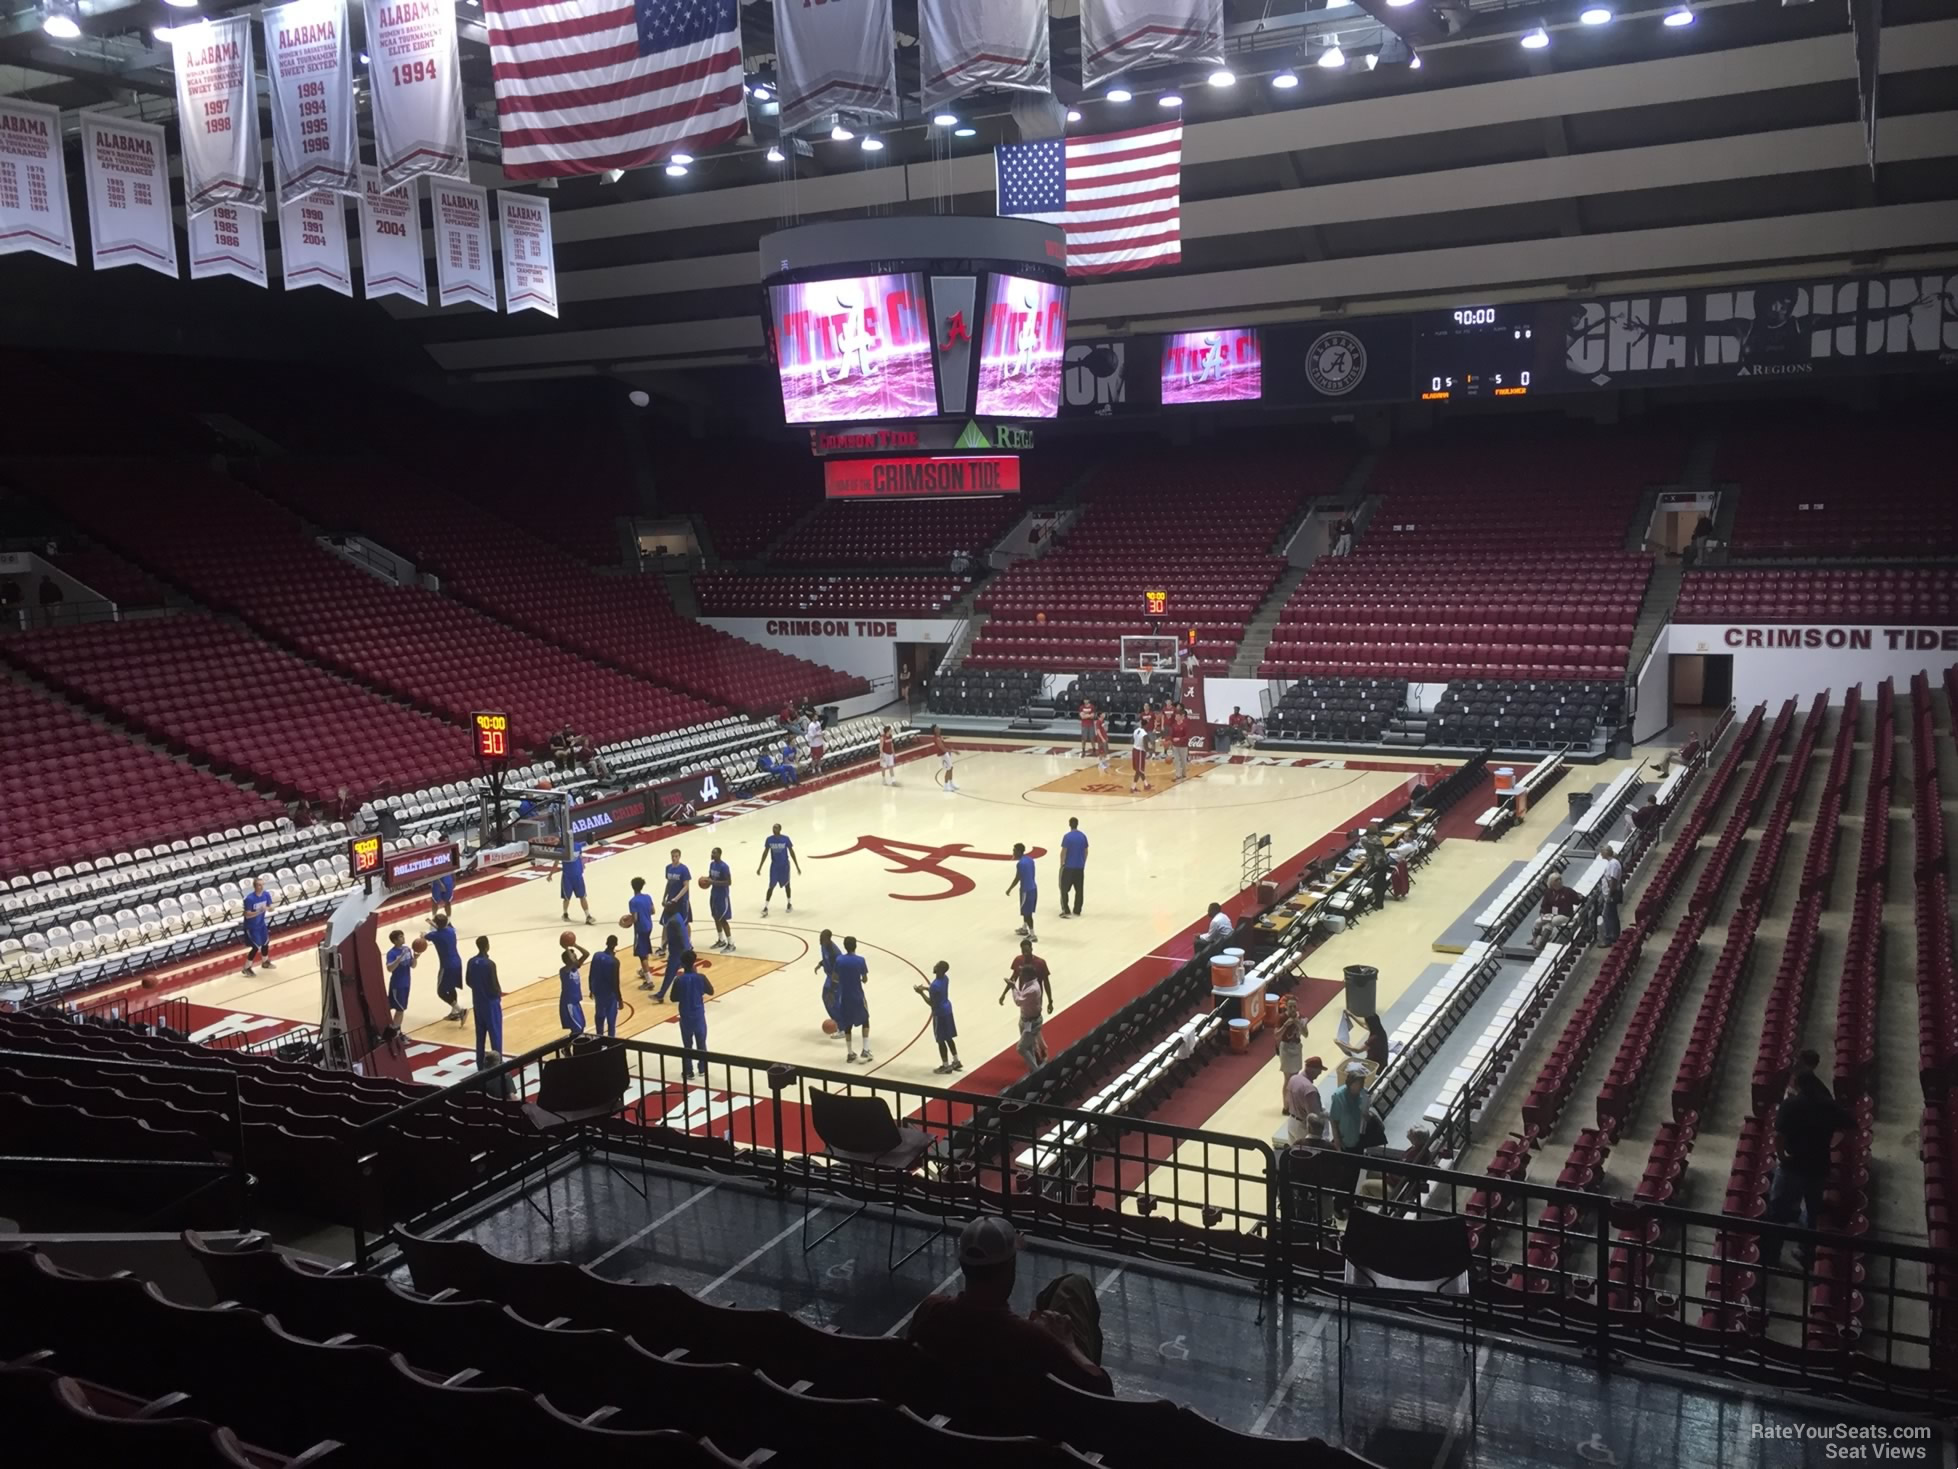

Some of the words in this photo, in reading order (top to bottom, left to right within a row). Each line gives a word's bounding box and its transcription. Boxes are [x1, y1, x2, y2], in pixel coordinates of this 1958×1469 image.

[279, 21, 335, 49] ALABAMA
[406, 23, 440, 34] BASKETB
[388, 44, 410, 56] ELITE
[412, 39, 435, 51] EIGHT
[280, 66, 305, 78] SWEET
[307, 60, 337, 72] SIXTEEN
[392, 58, 436, 86] 1994
[188, 85, 211, 96] SWEET
[298, 81, 324, 98] 1984
[204, 99, 229, 116] 1997
[299, 100, 326, 117] 1994
[205, 117, 231, 134] 1998
[300, 118, 328, 135] 1995
[96, 131, 154, 155] ALABAMA
[302, 137, 329, 154] 1996
[367, 181, 408, 199] ALAMA
[442, 193, 480, 211] ALABAMA
[214, 208, 237, 220] 1982
[301, 208, 324, 220] 1990
[508, 206, 542, 222] ALABAMA
[214, 220, 238, 234] 1985
[302, 221, 324, 234] 1991
[376, 220, 406, 237] 2004
[214, 234, 240, 247] 1986
[302, 234, 326, 246] 2004
[1454, 308, 1495, 325] 90:00
[1313, 338, 1359, 361] ALABAMA
[1753, 364, 1812, 376] REGIONS
[1432, 377, 1441, 391] 0
[1446, 377, 1452, 387] 5
[1495, 374, 1502, 384] 5
[1521, 372, 1530, 386] 0
[820, 431, 876, 448] CRIMSON
[877, 428, 918, 447] TIDE
[873, 463, 964, 492] CRIMSON
[968, 462, 1000, 489] TIDE
[1146, 592, 1165, 600] 90:00
[1150, 600, 1163, 612] 30
[766, 620, 849, 636] CRIMSON
[855, 622, 897, 637] TIDE
[1724, 628, 1872, 650] CRIMSON
[1883, 629, 1958, 650] TIDE
[477, 716, 505, 730] 90:00
[482, 731, 503, 754] 30
[571, 812, 612, 833] ABAMA
[612, 802, 645, 820] CRIMS
[354, 839, 378, 854] 90:00
[359, 852, 375, 868] 30
[394, 854, 450, 876] ROLLTIDE.COM
